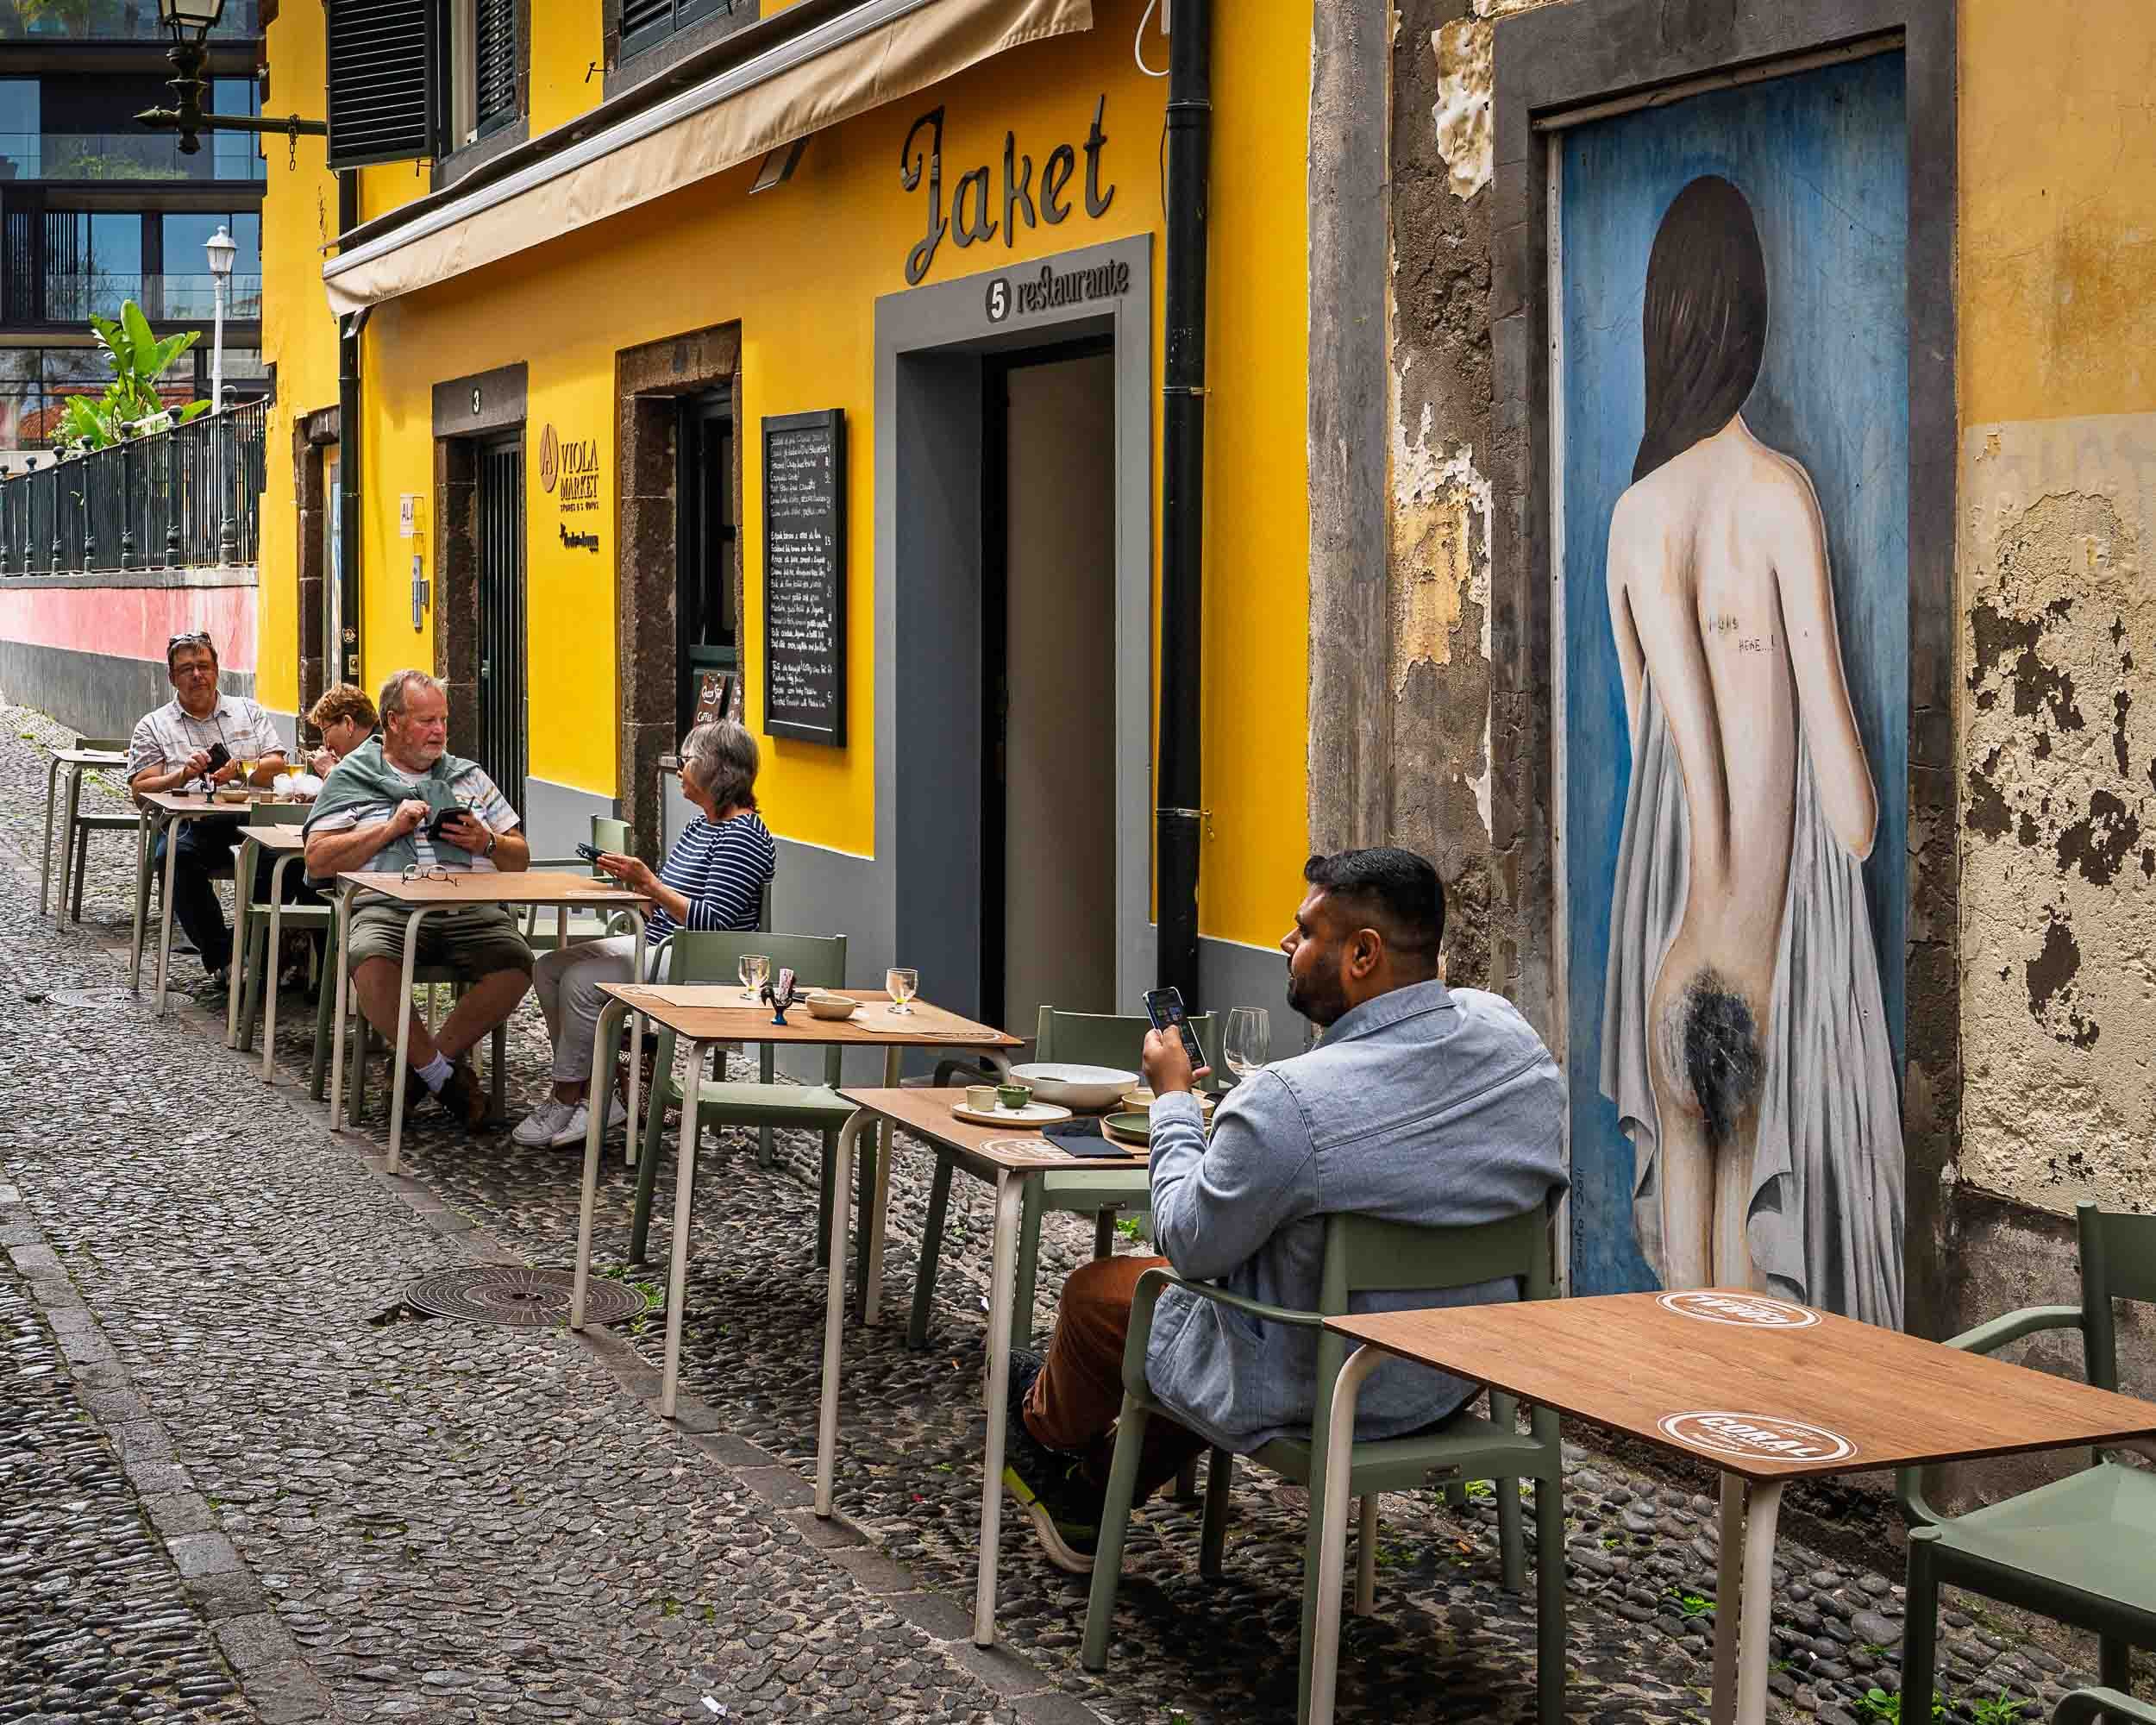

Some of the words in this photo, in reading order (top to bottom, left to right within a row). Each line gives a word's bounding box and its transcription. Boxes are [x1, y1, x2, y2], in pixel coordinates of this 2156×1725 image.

[900, 93, 1116, 285] Jaket
[990, 281, 1006, 320] 5
[1017, 259, 1131, 314] restaurante
[473, 389, 480, 413] 3
[561, 438, 599, 474] VIOLA
[561, 475, 599, 501] MARKET
[1696, 1416, 1822, 1458] CORAL
